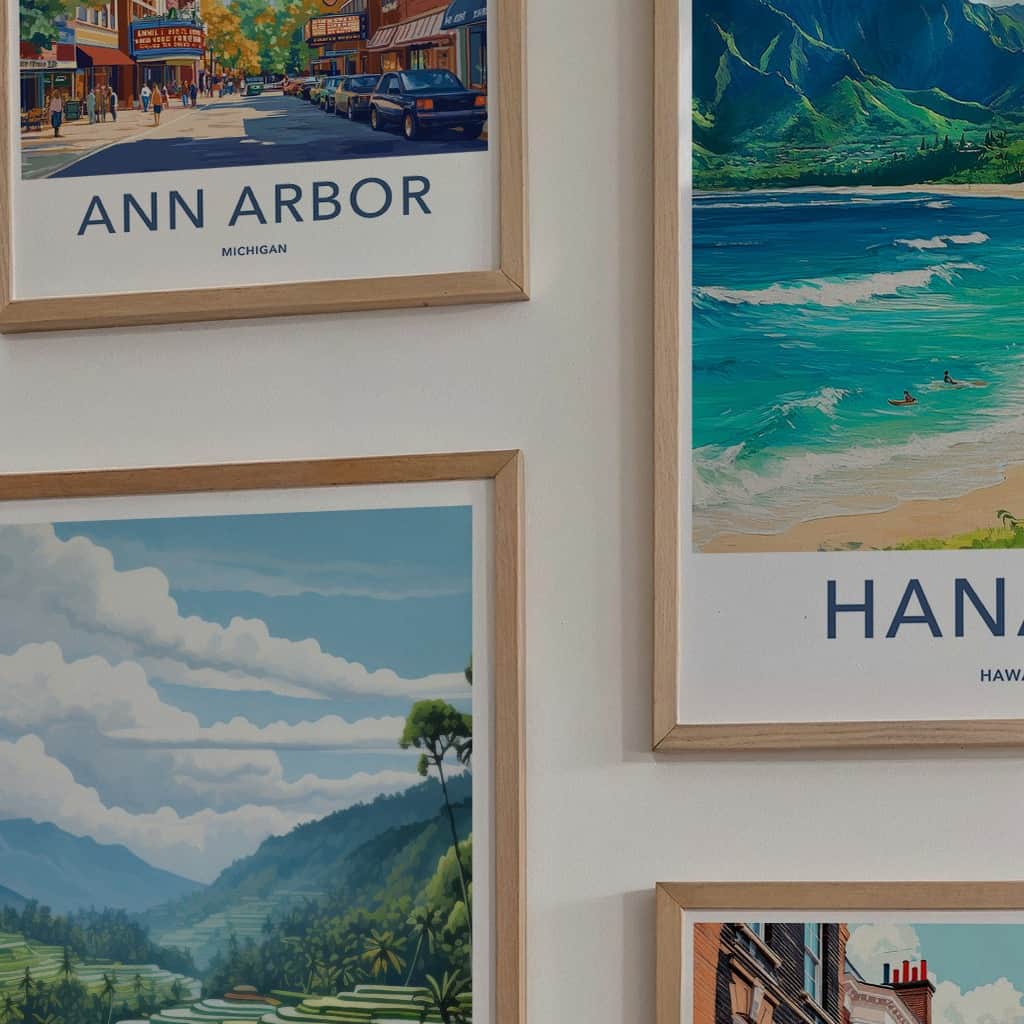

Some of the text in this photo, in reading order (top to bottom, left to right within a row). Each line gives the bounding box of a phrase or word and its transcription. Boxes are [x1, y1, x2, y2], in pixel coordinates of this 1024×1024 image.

[77, 175, 432, 236] ANN ARBOR
[221, 243, 288, 257] MICHIGAN
[826, 577, 1024, 640] HAN
[980, 668, 1024, 682] HAW
